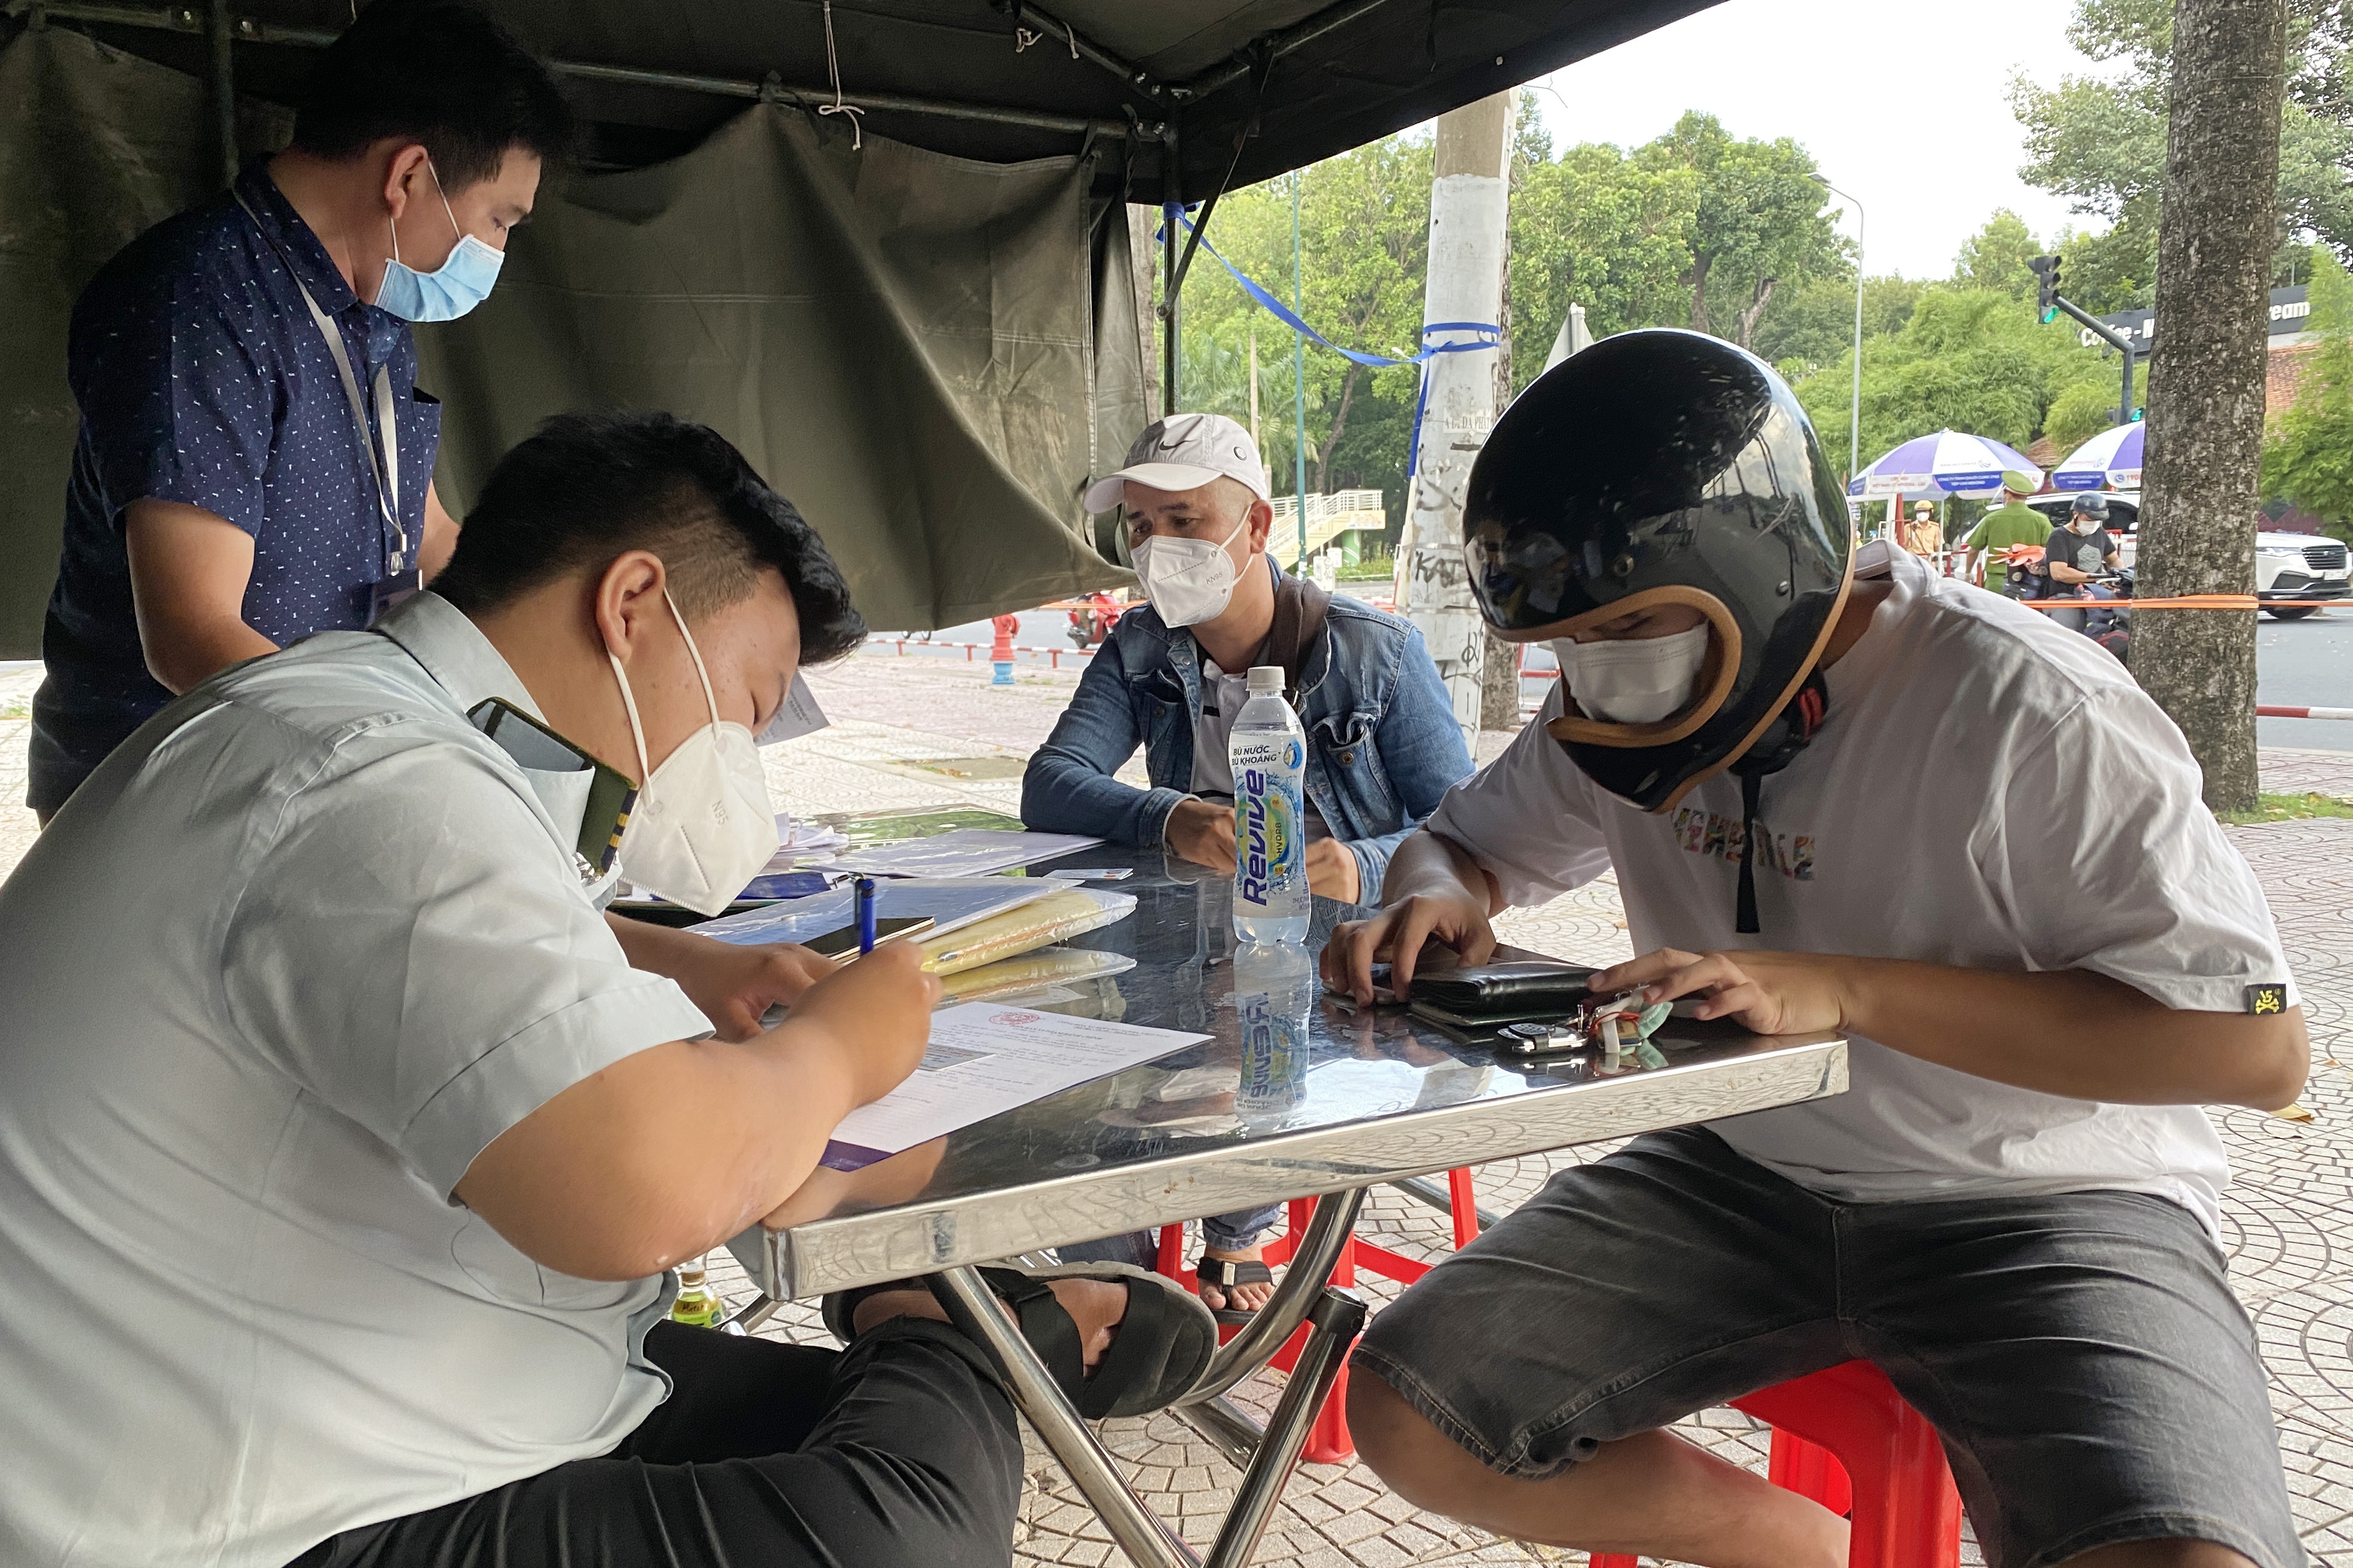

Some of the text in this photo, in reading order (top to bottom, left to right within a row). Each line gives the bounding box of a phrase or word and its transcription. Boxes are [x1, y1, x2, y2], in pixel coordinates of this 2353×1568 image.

[1206, 571, 1223, 584] KN95
[1233, 745, 1270, 756] BÙ NƯỚC
[1240, 754, 1277, 766] KHOÁNG
[711, 799, 728, 825] N95
